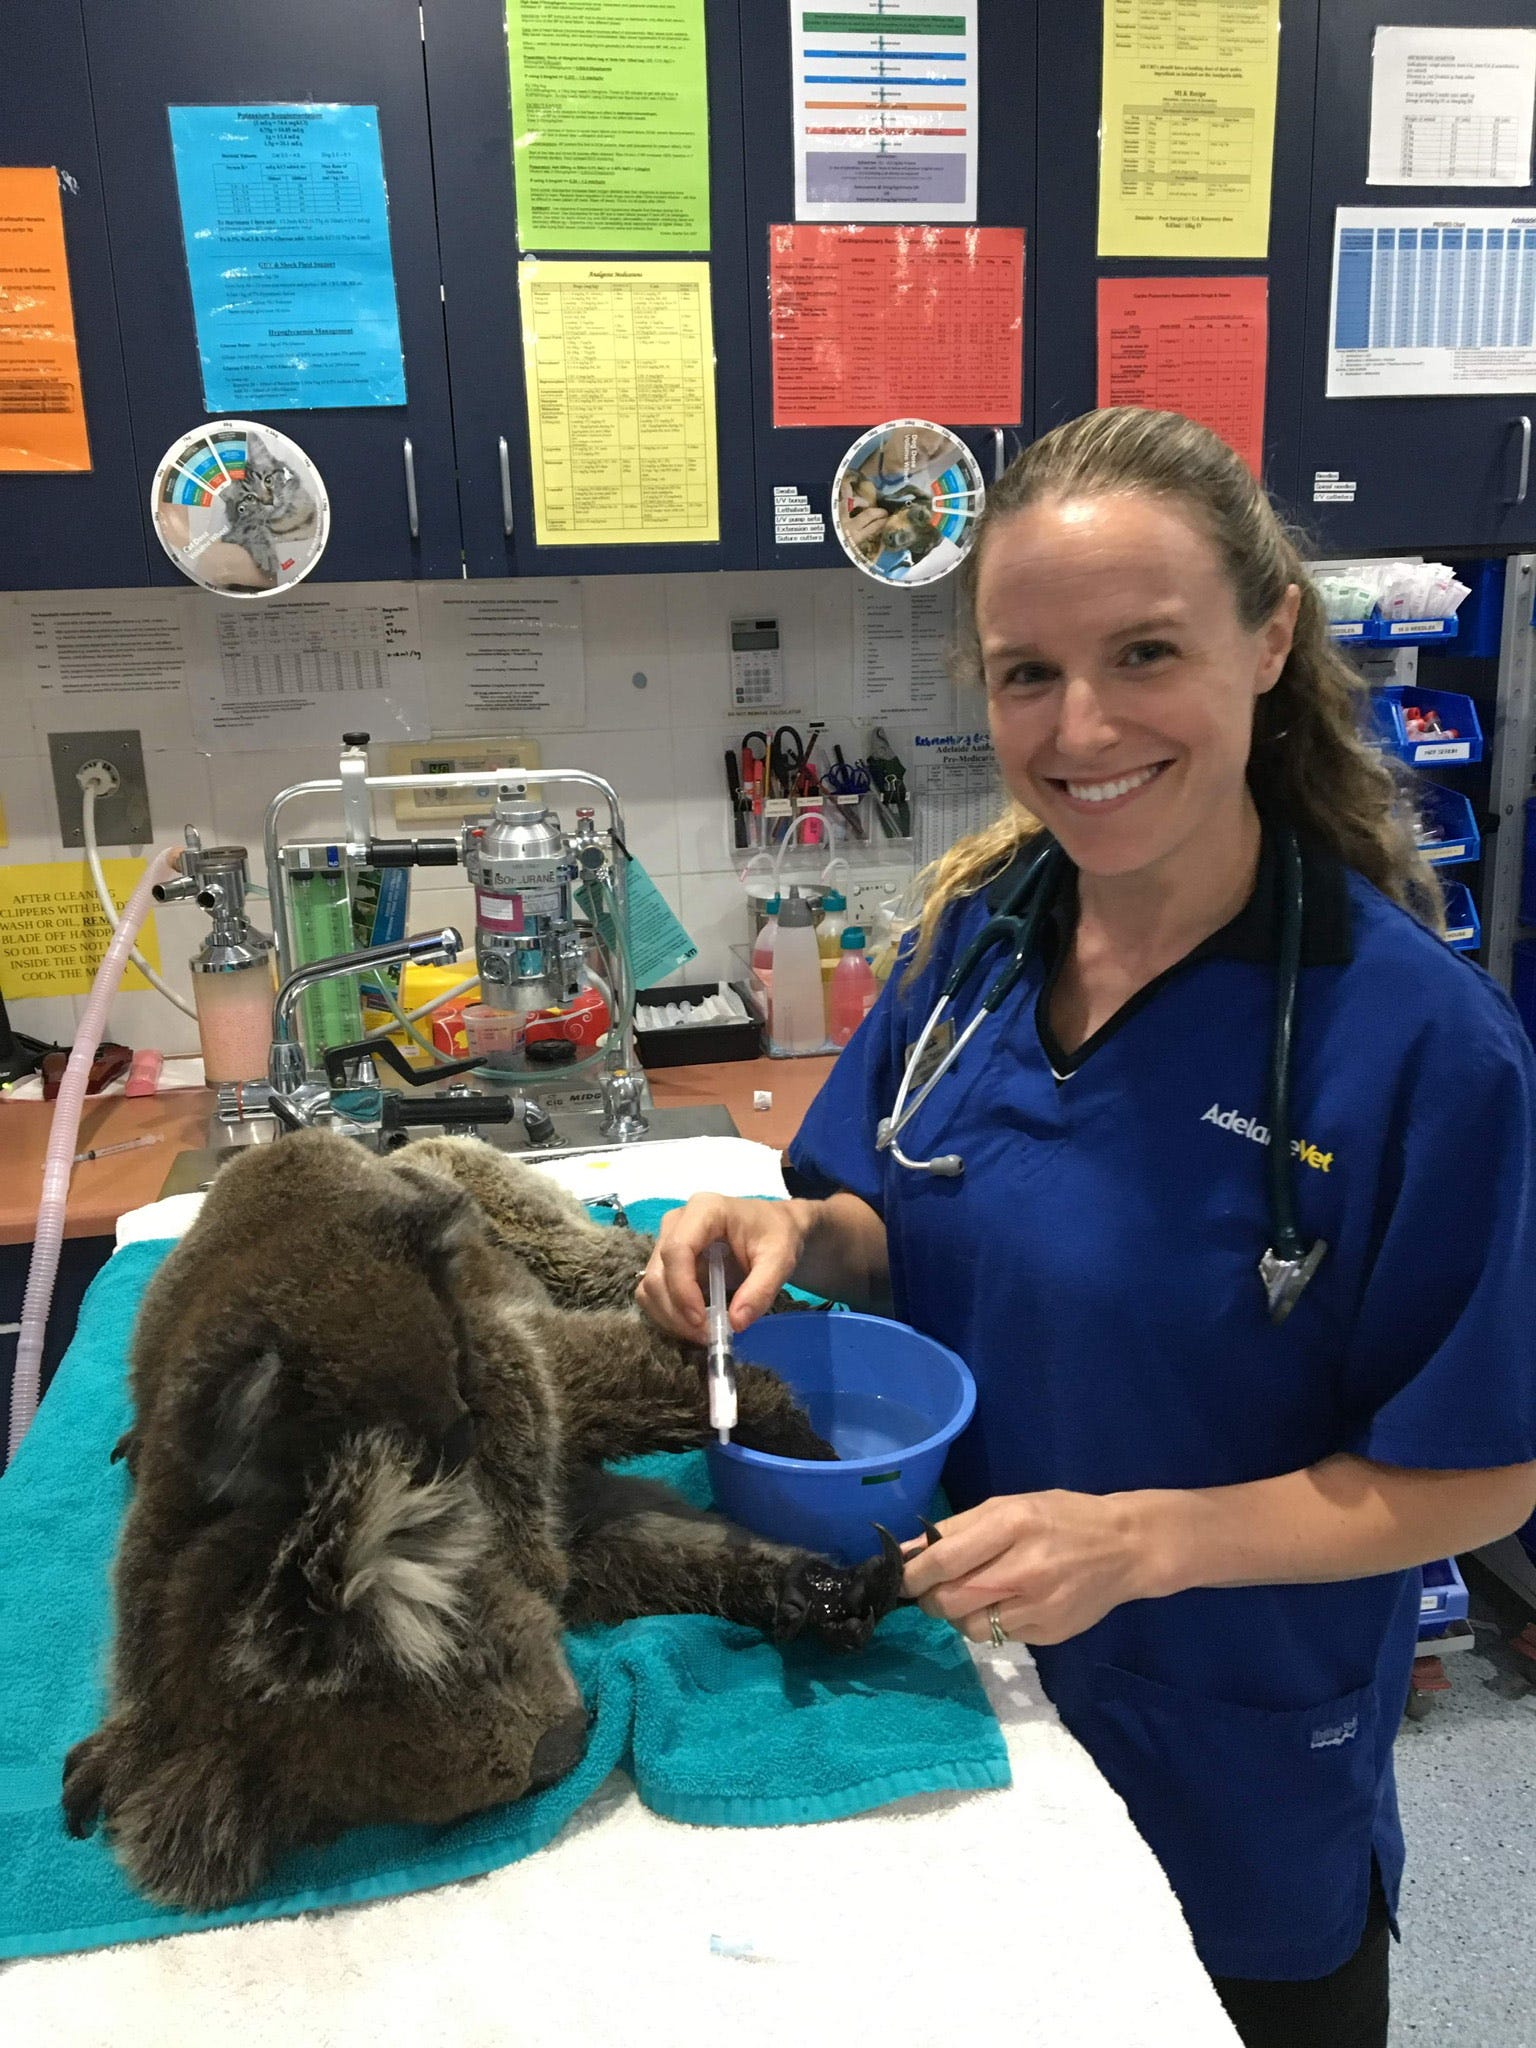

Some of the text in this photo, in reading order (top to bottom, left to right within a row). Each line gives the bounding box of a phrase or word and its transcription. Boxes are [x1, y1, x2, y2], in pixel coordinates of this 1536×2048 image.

[910, 434, 918, 469] Dog Dose
[494, 873, 555, 885] ISOURANE
[13, 889, 116, 905] AFTER CLEANIG
[0, 905, 90, 919] CLIPPERS WITH
[0, 921, 34, 931] WASH
[36, 919, 54, 929] OR
[2, 928, 115, 945] BLADE OFF HANDP
[4, 947, 20, 958] SO
[22, 946, 43, 956] OIL
[46, 944, 77, 954] DOES
[80, 942, 104, 952] NOT
[11, 958, 51, 970] INSIDE
[54, 956, 76, 967] THE
[22, 970, 57, 982] COOK
[59, 969, 82, 979] THE
